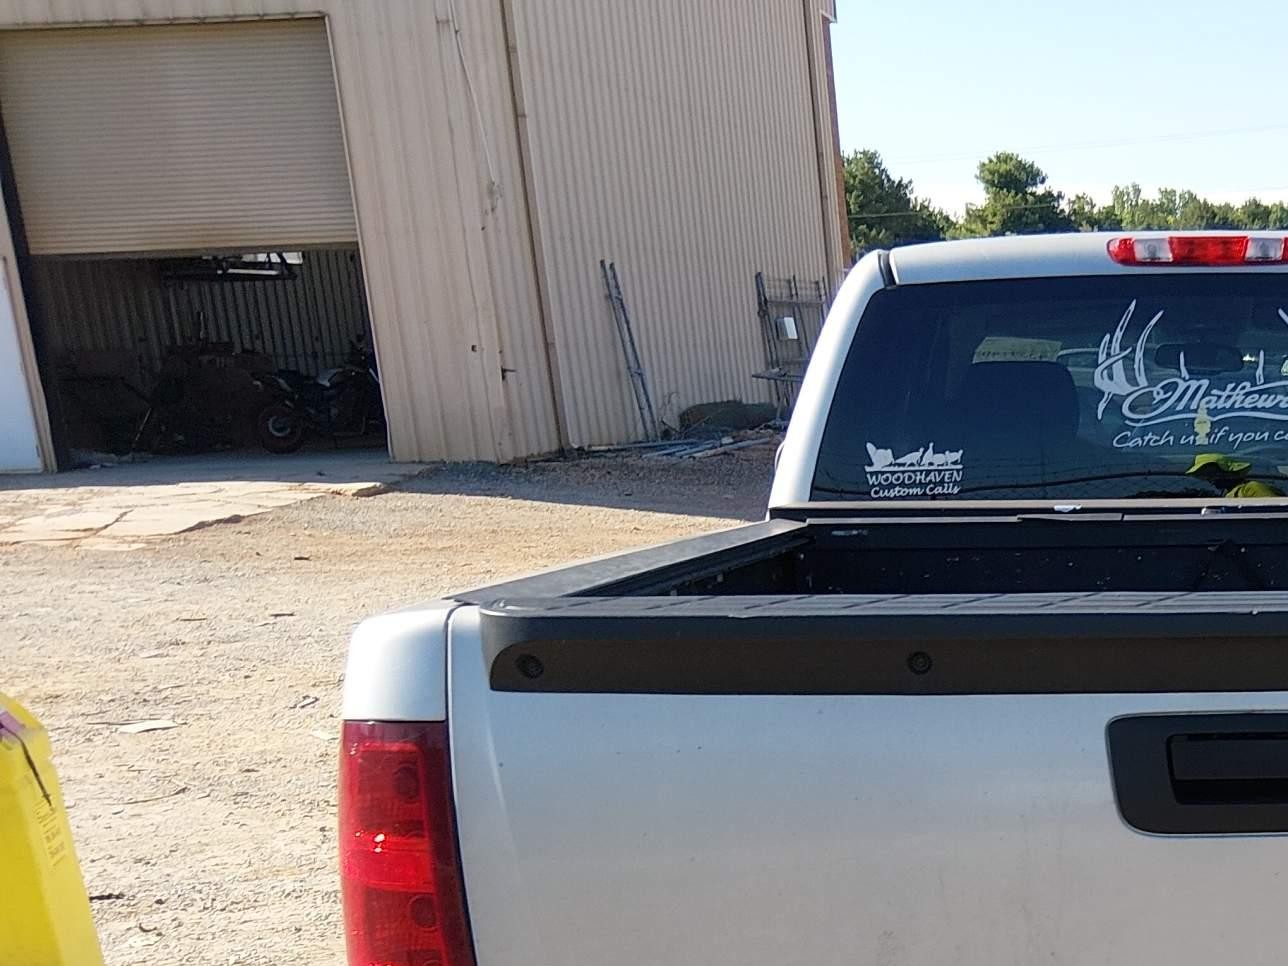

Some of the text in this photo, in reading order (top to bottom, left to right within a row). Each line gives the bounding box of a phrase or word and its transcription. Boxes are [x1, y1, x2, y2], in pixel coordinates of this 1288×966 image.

[1112, 431, 1174, 448] Catch
[1209, 426, 1229, 444] if
[1228, 430, 1268, 450] you
[866, 470, 963, 486] WOODHAVEN
[870, 482, 961, 498] Custom Calls
